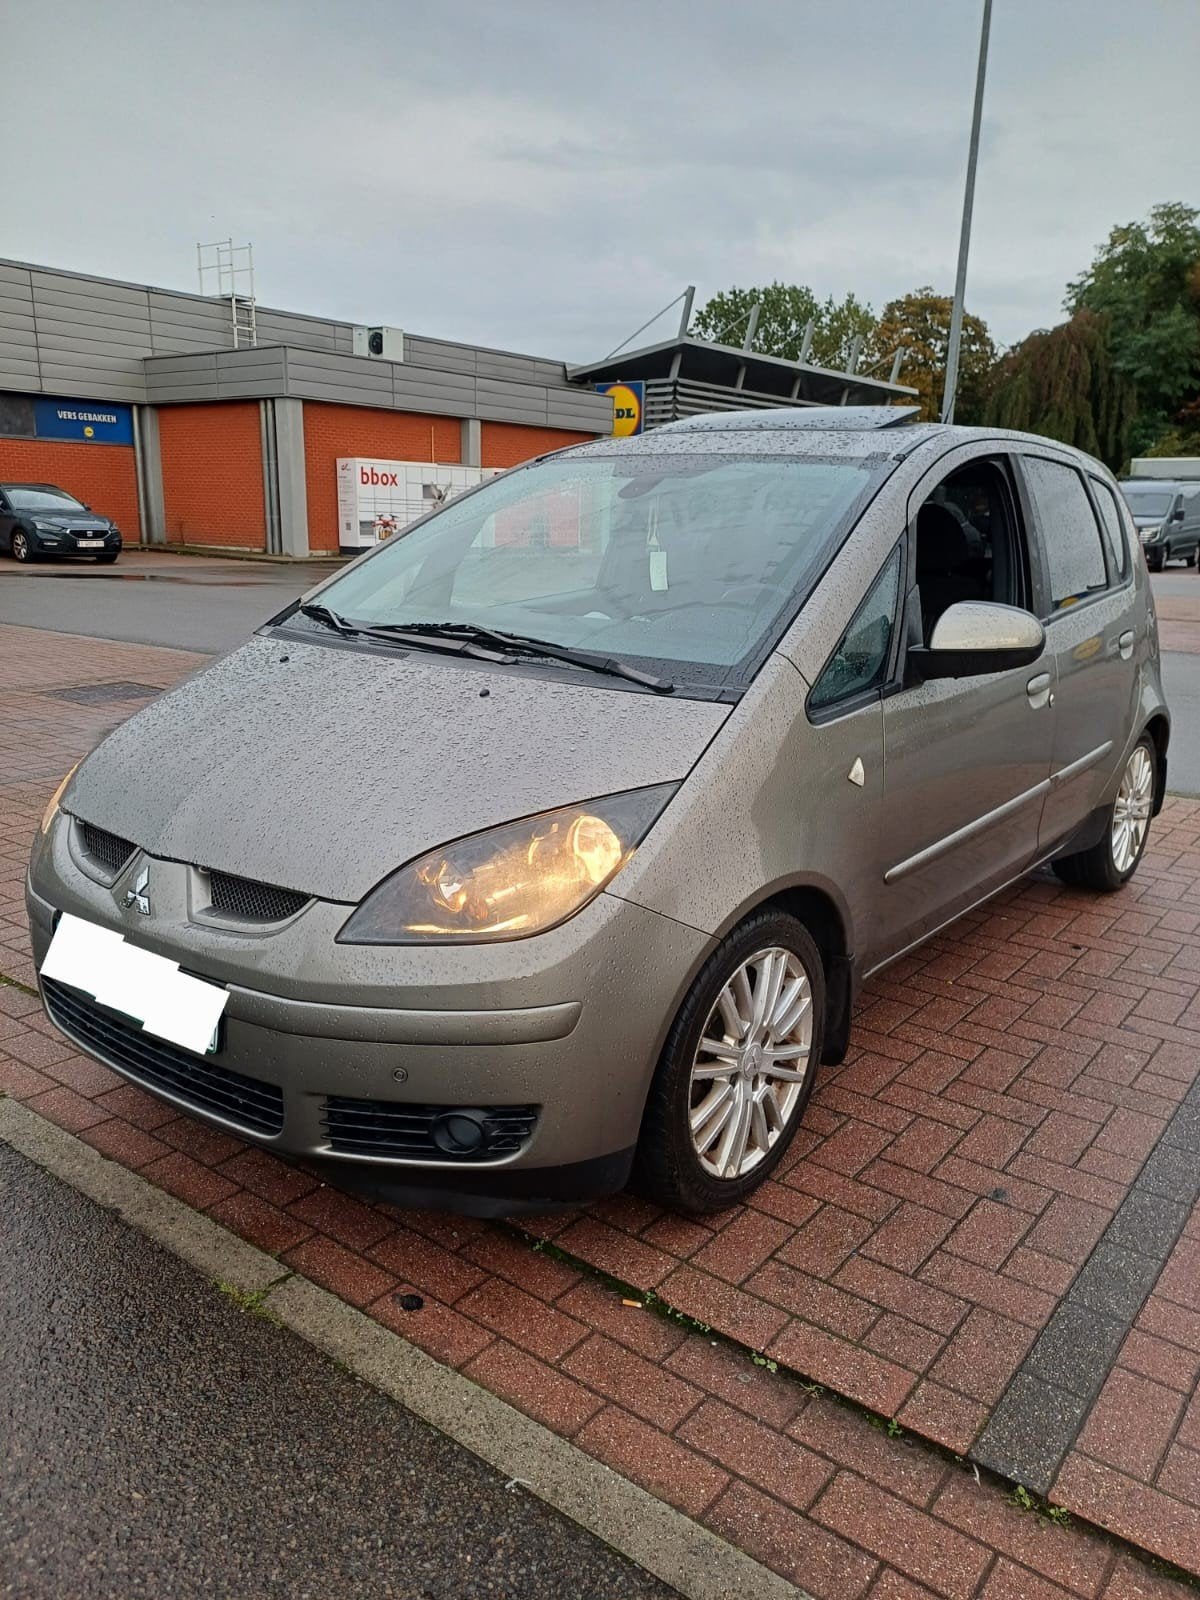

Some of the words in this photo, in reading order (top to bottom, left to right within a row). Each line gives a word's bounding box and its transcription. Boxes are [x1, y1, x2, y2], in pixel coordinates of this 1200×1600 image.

[57, 410, 77, 419] VERS
[78, 412, 116, 423] GEBAKKEN
[615, 408, 635, 418] DL
[360, 466, 398, 486] bbox
